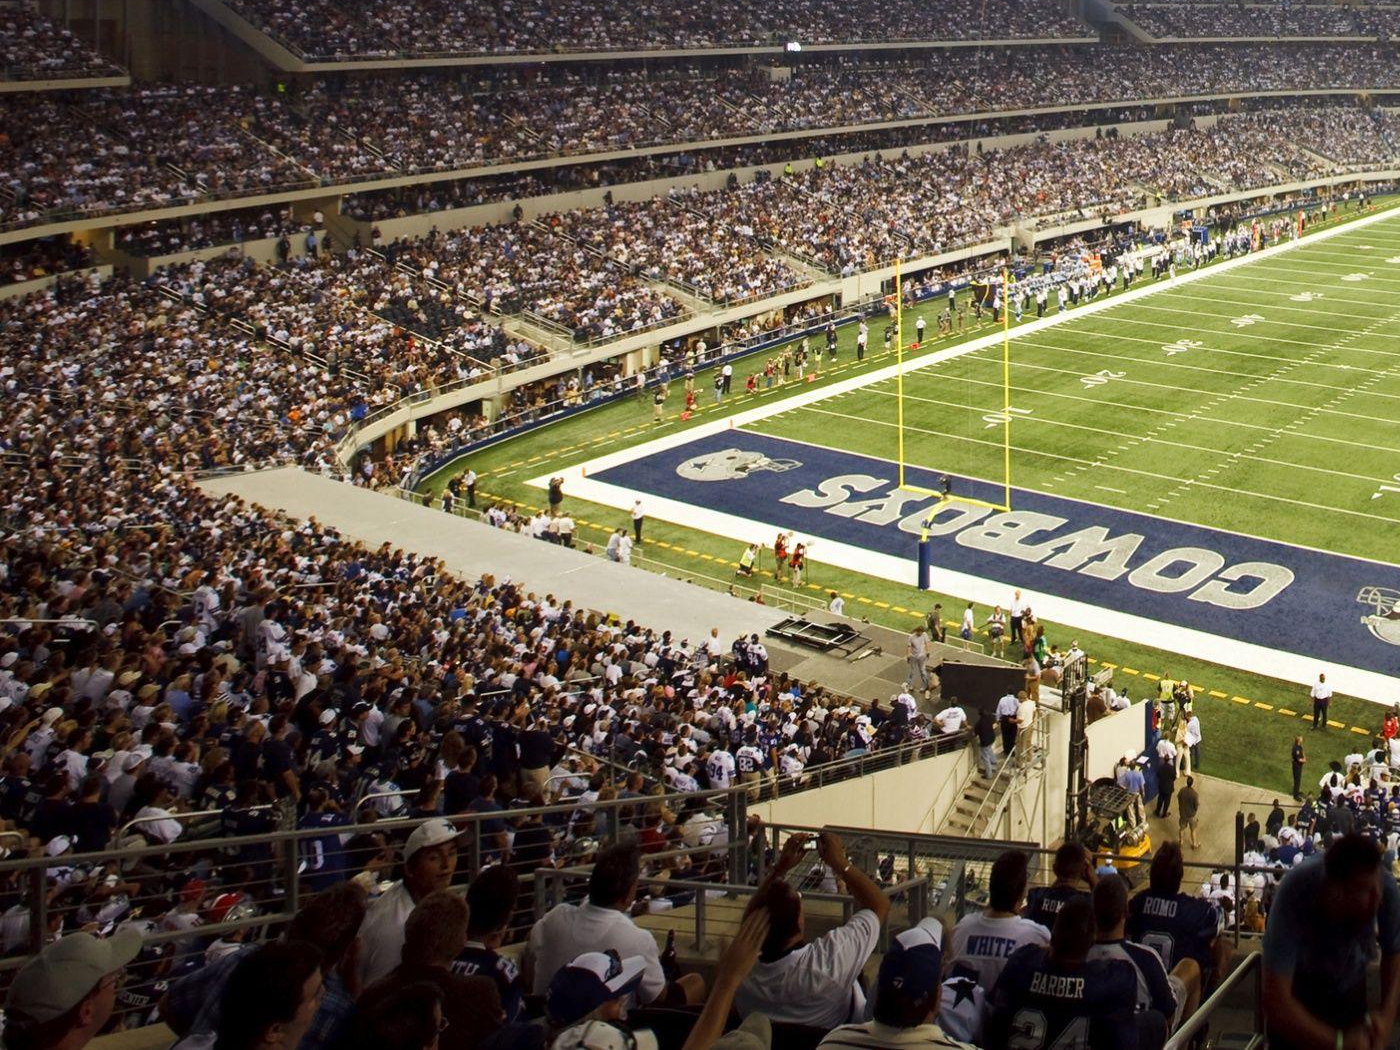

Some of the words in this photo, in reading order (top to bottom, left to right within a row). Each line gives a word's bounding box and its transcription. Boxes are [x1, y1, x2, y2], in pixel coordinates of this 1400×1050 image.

[1080, 369, 1126, 385] 20
[780, 474, 1294, 610] COWBOYS
[1143, 896, 1177, 918] ROMO
[967, 935, 1017, 957] WHITE
[1029, 971, 1084, 999] BARBER
[1006, 1006, 1090, 1050] 24
